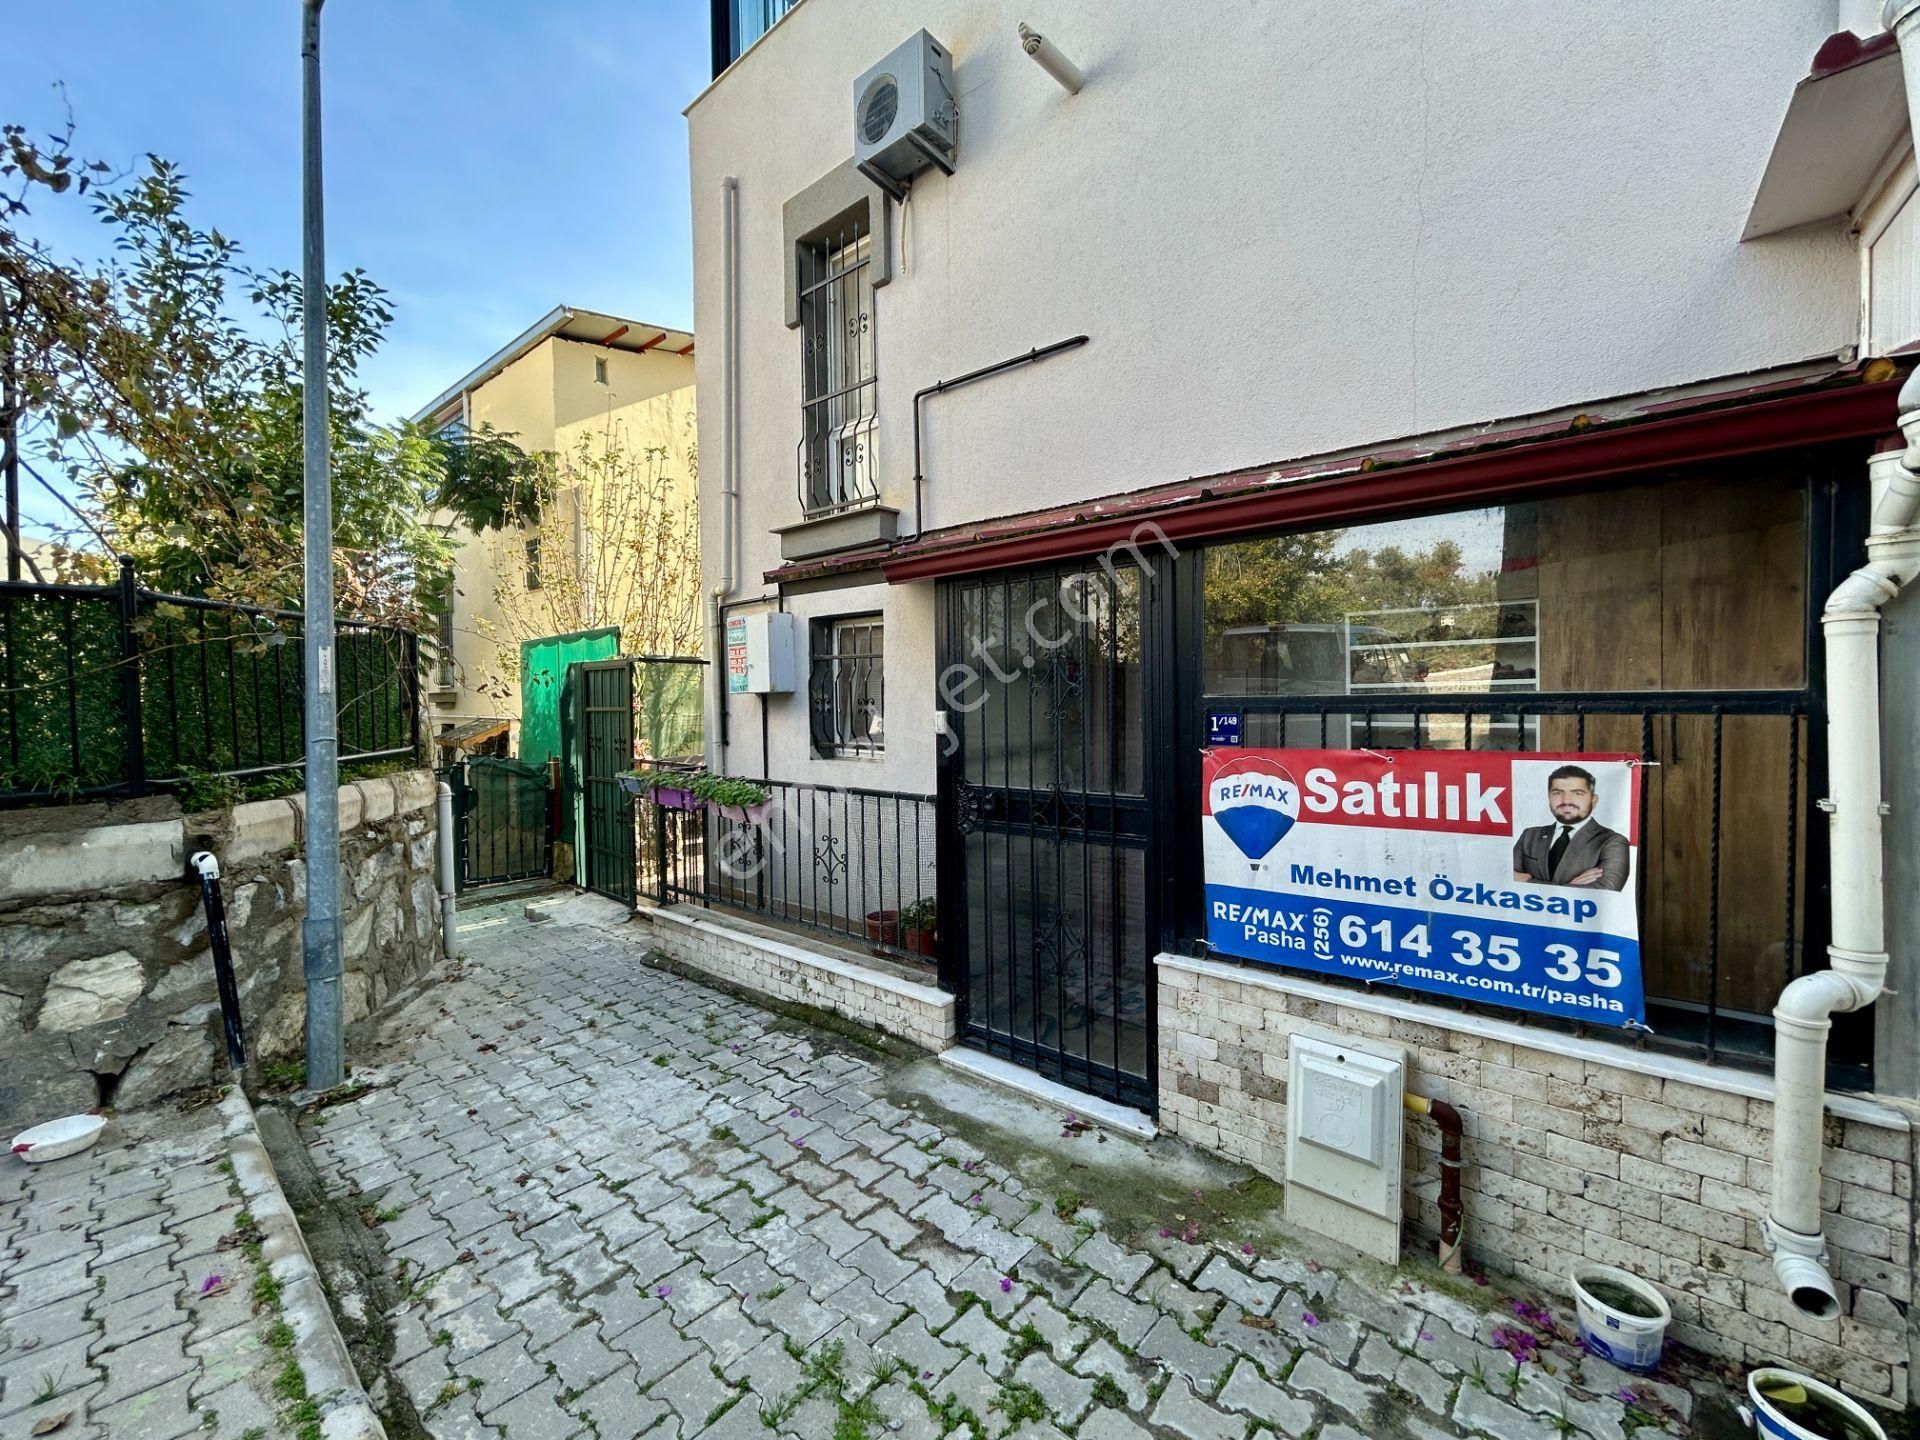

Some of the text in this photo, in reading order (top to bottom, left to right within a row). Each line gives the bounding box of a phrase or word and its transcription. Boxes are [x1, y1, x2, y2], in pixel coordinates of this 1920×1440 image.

[1220, 783, 1289, 805] RE/MAX
[1303, 767, 1508, 824] Satılık
[1213, 901, 1306, 933] RE/MAX
[1290, 864, 1598, 923] Mehmet Özkasap
[1244, 924, 1306, 951] Pasha
[1313, 907, 1623, 988] (256) 614 35 35
[1340, 954, 1624, 1013] www.remax.com.tr/pasha
